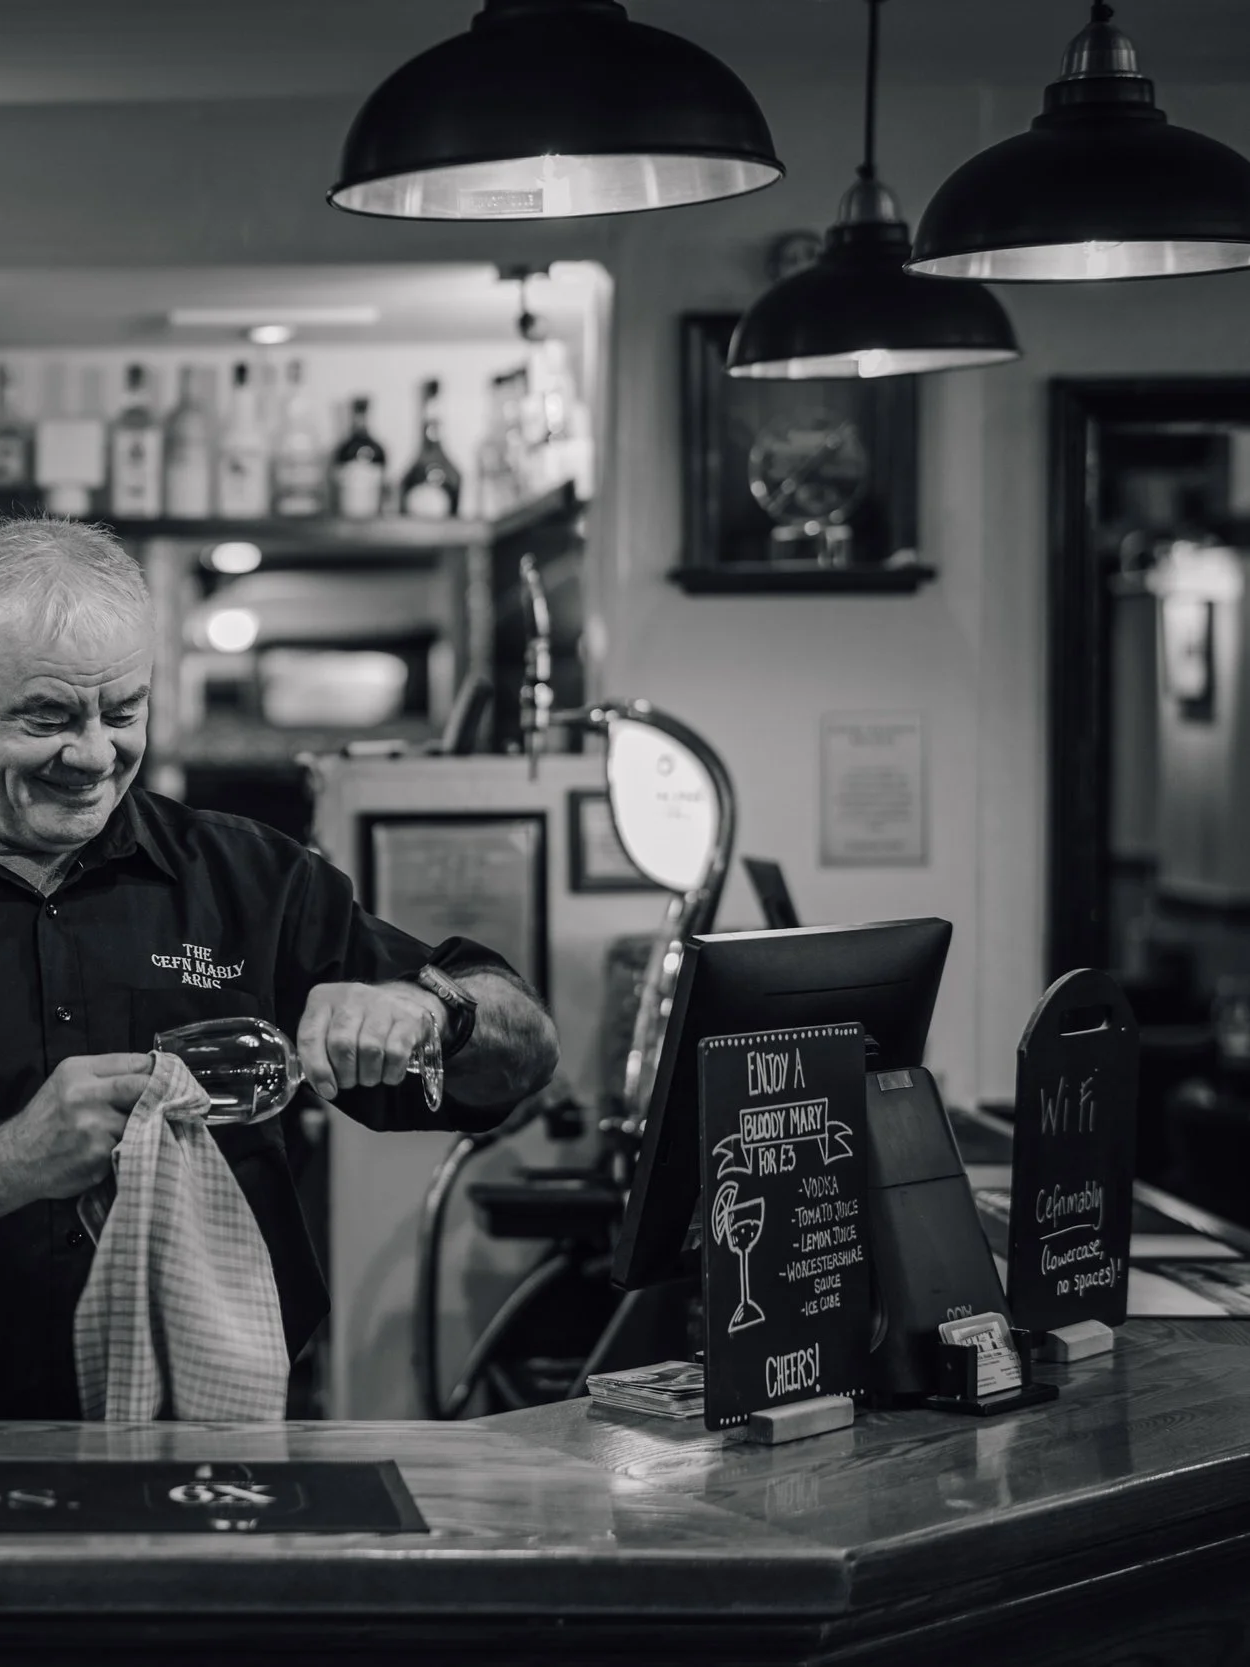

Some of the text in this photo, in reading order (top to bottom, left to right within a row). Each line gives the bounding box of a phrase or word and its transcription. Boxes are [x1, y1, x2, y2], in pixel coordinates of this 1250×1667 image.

[182, 943, 213, 962] THE
[151, 953, 246, 979] CEFN MABLY
[181, 971, 222, 989] ARMS
[747, 1047, 806, 1096] ENJOY A
[743, 1104, 823, 1143] BLOODY MARY
[758, 1146, 778, 1177] FOR
[835, 1198, 859, 1223] JUICE
[832, 1224, 857, 1246] JUICE
[814, 1274, 842, 1295] SAUCE
[1056, 1278, 1070, 1297] no
[819, 1292, 841, 1312] CUBE
[766, 1341, 821, 1398] CHEERS!
